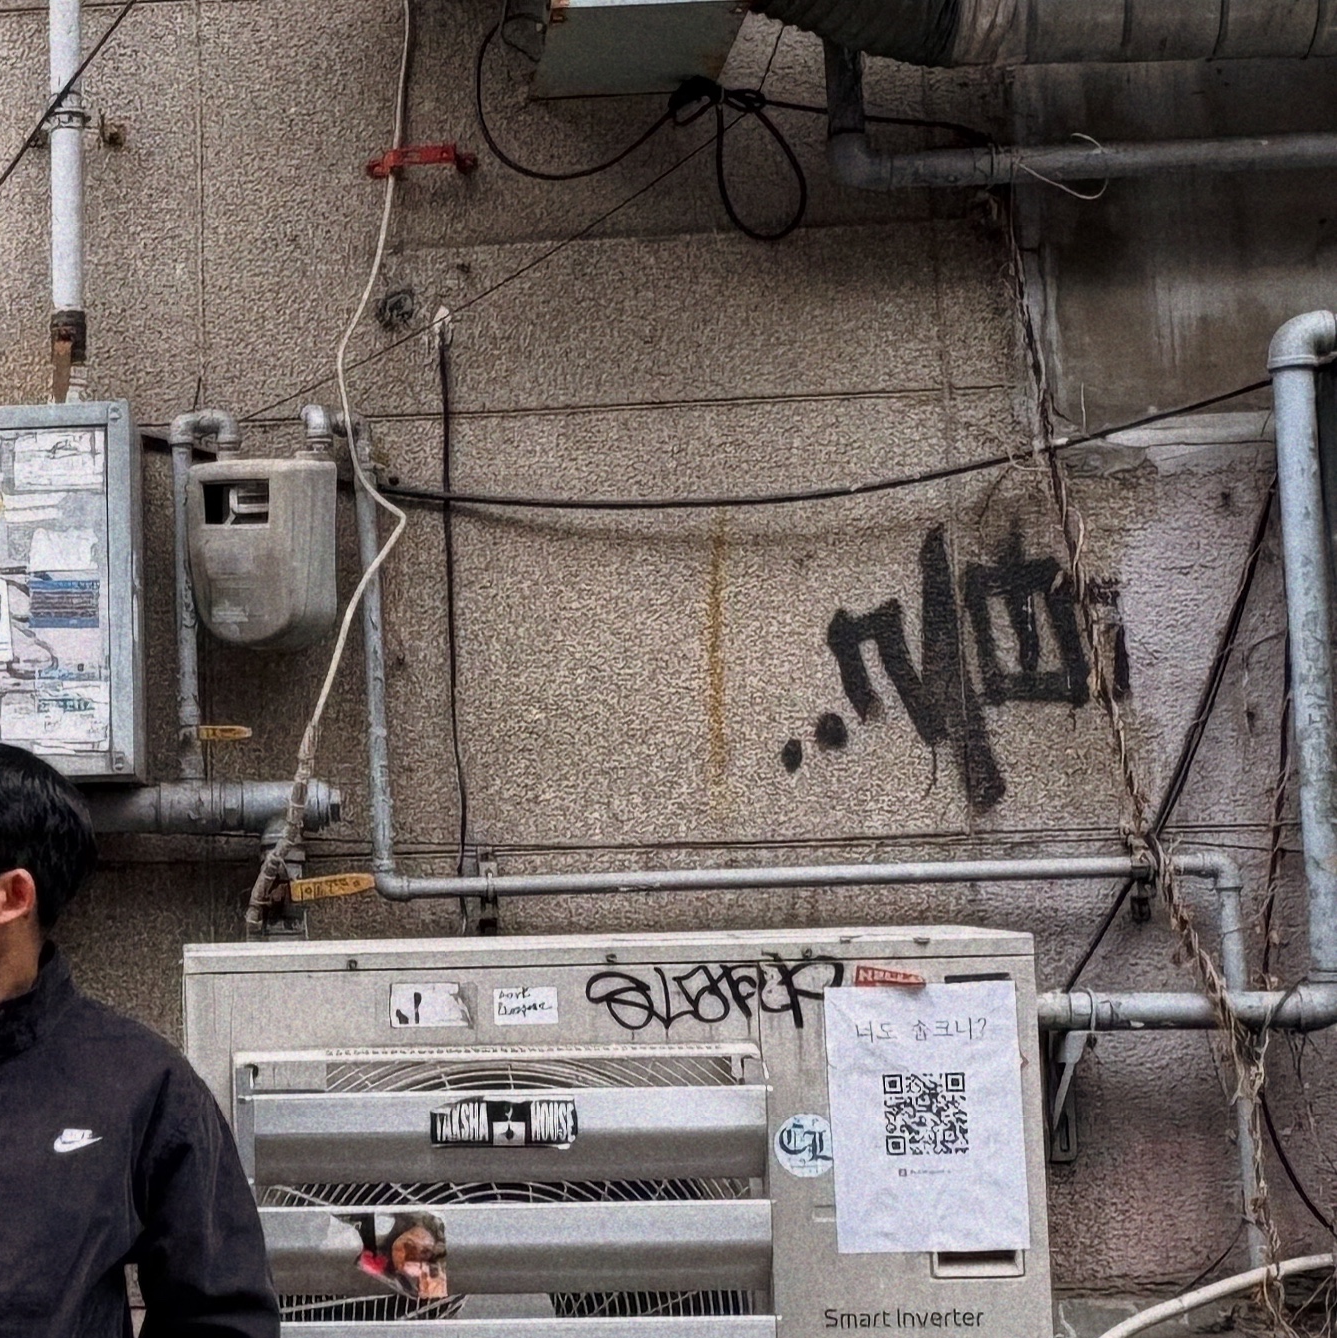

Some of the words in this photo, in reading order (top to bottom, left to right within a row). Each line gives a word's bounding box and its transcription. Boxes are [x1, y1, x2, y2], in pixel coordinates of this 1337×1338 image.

[530, 1100, 576, 1142] HOUSE
[824, 1308, 891, 1329] Smart
[896, 1307, 984, 1328] Inverter
